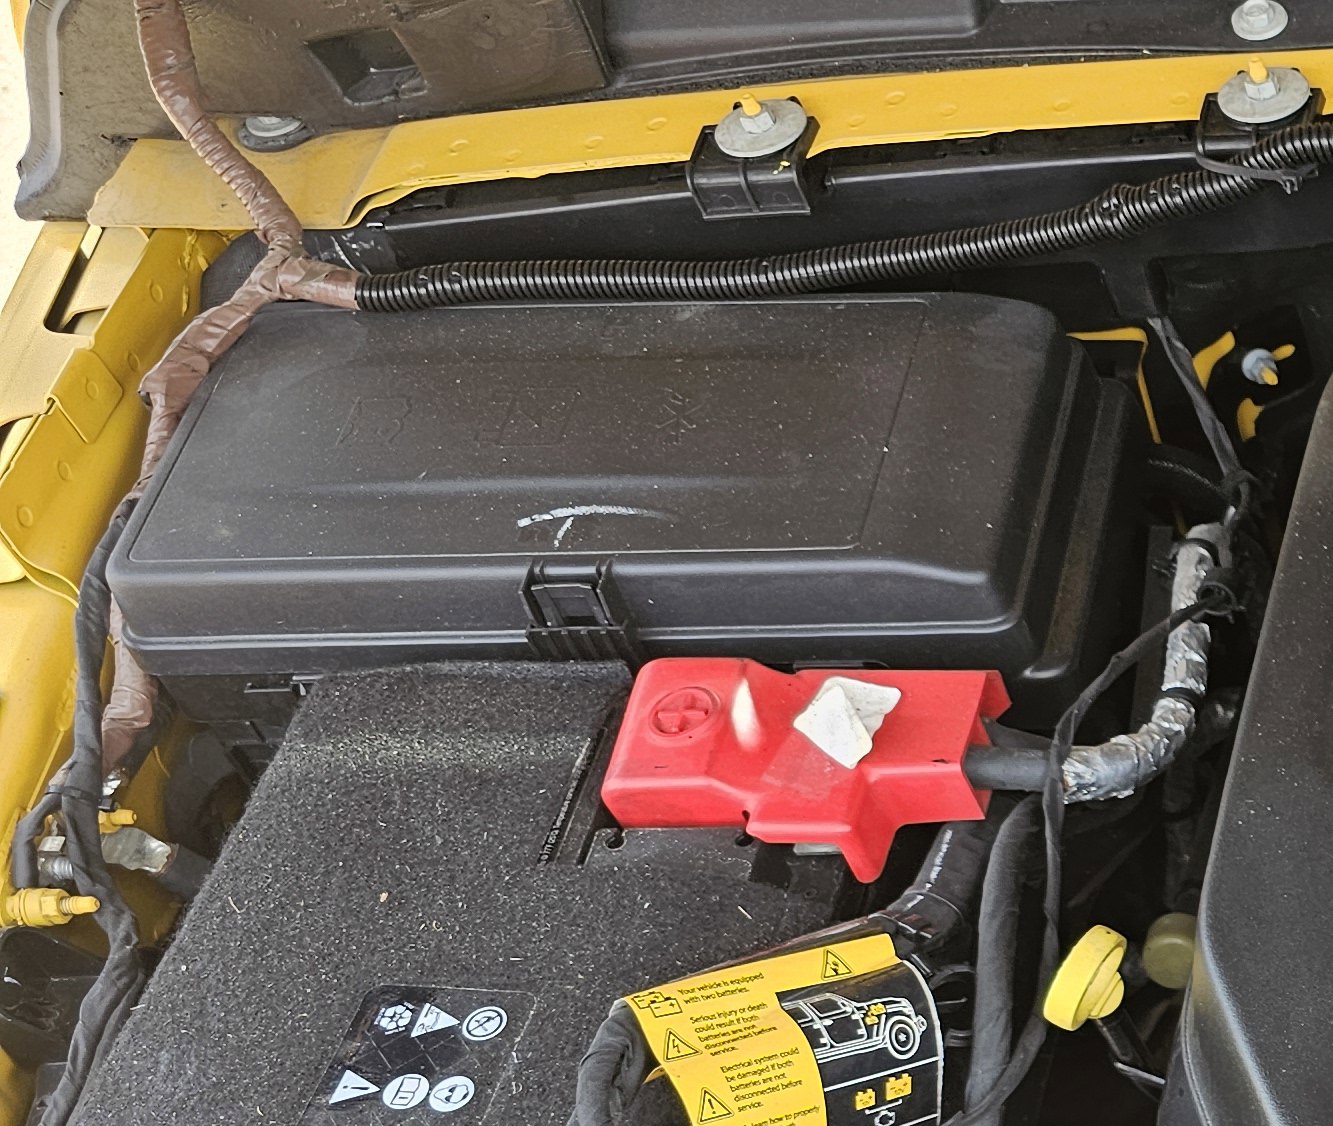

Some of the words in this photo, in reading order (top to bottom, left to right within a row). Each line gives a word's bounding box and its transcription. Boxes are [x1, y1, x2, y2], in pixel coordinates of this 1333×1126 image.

[697, 981, 721, 991] vehicle
[730, 972, 764, 985] equipped
[683, 996, 701, 1004] with
[716, 987, 750, 999] batteries.
[690, 1013, 715, 1024] Serious
[716, 1008, 738, 1020] injury
[748, 1002, 768, 1011] death
[695, 1024, 715, 1033] could
[716, 1019, 735, 1029] result
[735, 1016, 741, 1025] if
[742, 1015, 759, 1023] both
[698, 1031, 730, 1042] batteries
[742, 1024, 756, 1032] not
[720, 1059, 753, 1073] Electrical
[754, 1054, 778, 1066] system
[780, 1048, 800, 1058] could
[737, 1066, 770, 1080] damaged
[771, 1063, 776, 1071] if
[777, 1060, 794, 1069] both
[730, 1080, 761, 1092] batteries
[775, 1073, 787, 1081] not
[734, 1086, 781, 1102] disconnected
[781, 1080, 803, 1090] before
[738, 1102, 764, 1112] service.
[769, 1116, 784, 1124] how
[793, 1105, 820, 1119] properly
